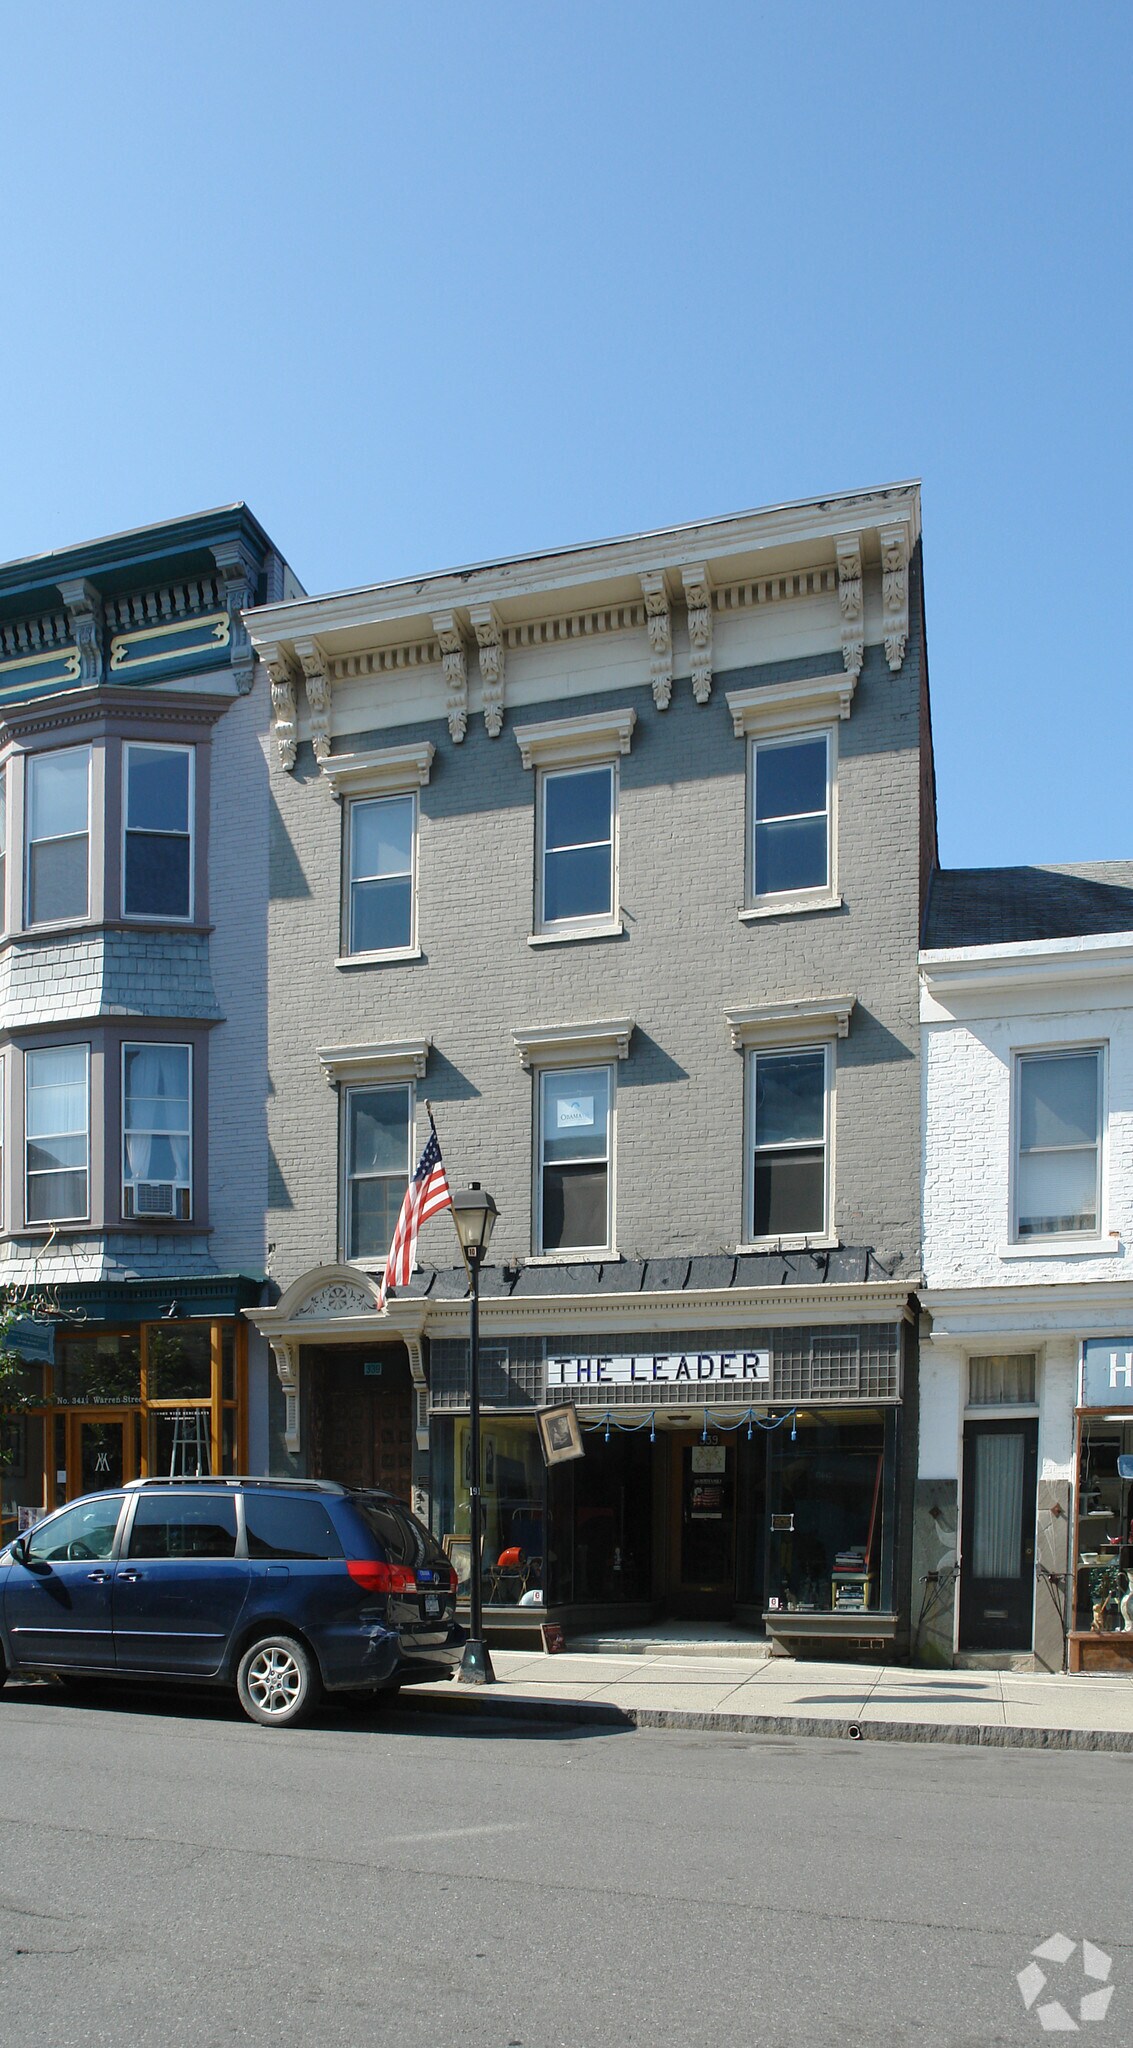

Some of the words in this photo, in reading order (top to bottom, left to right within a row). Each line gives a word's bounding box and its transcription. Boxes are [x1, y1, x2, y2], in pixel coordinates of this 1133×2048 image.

[554, 1358, 613, 1383] THE
[631, 1353, 760, 1381] LEADER
[93, 1395, 121, 1404] Warren
